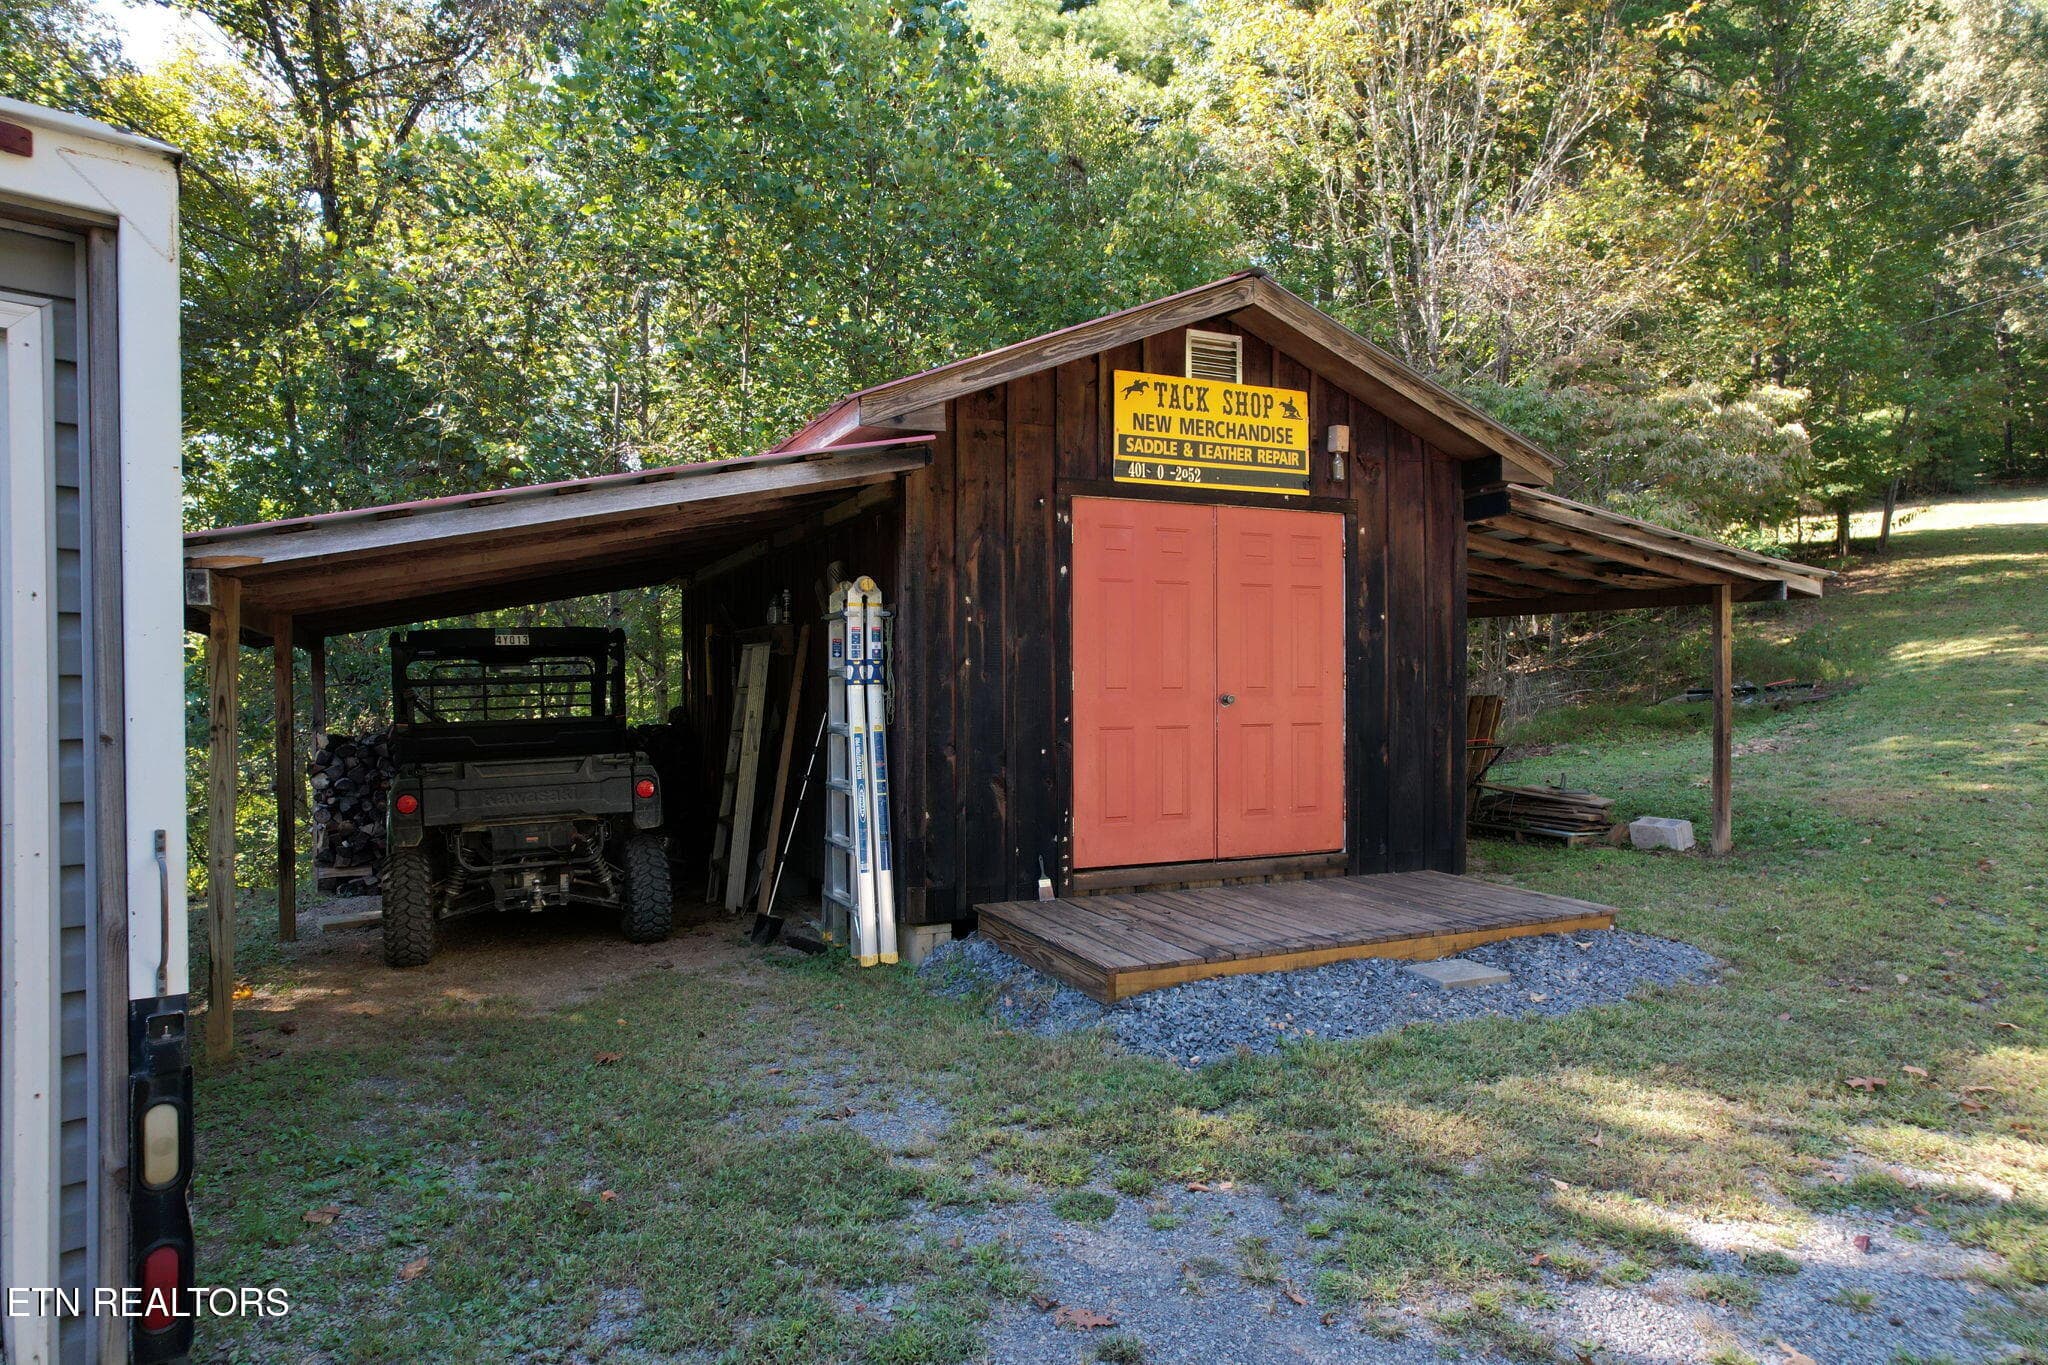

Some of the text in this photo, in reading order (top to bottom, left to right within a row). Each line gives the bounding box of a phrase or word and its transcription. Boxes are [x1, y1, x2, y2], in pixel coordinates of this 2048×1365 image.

[1153, 381, 1274, 419] TACK SHOP
[1132, 412, 1293, 445] NEW MERCHANDISE
[1126, 437, 1300, 466] SADDLE & LEATHER REPAIR
